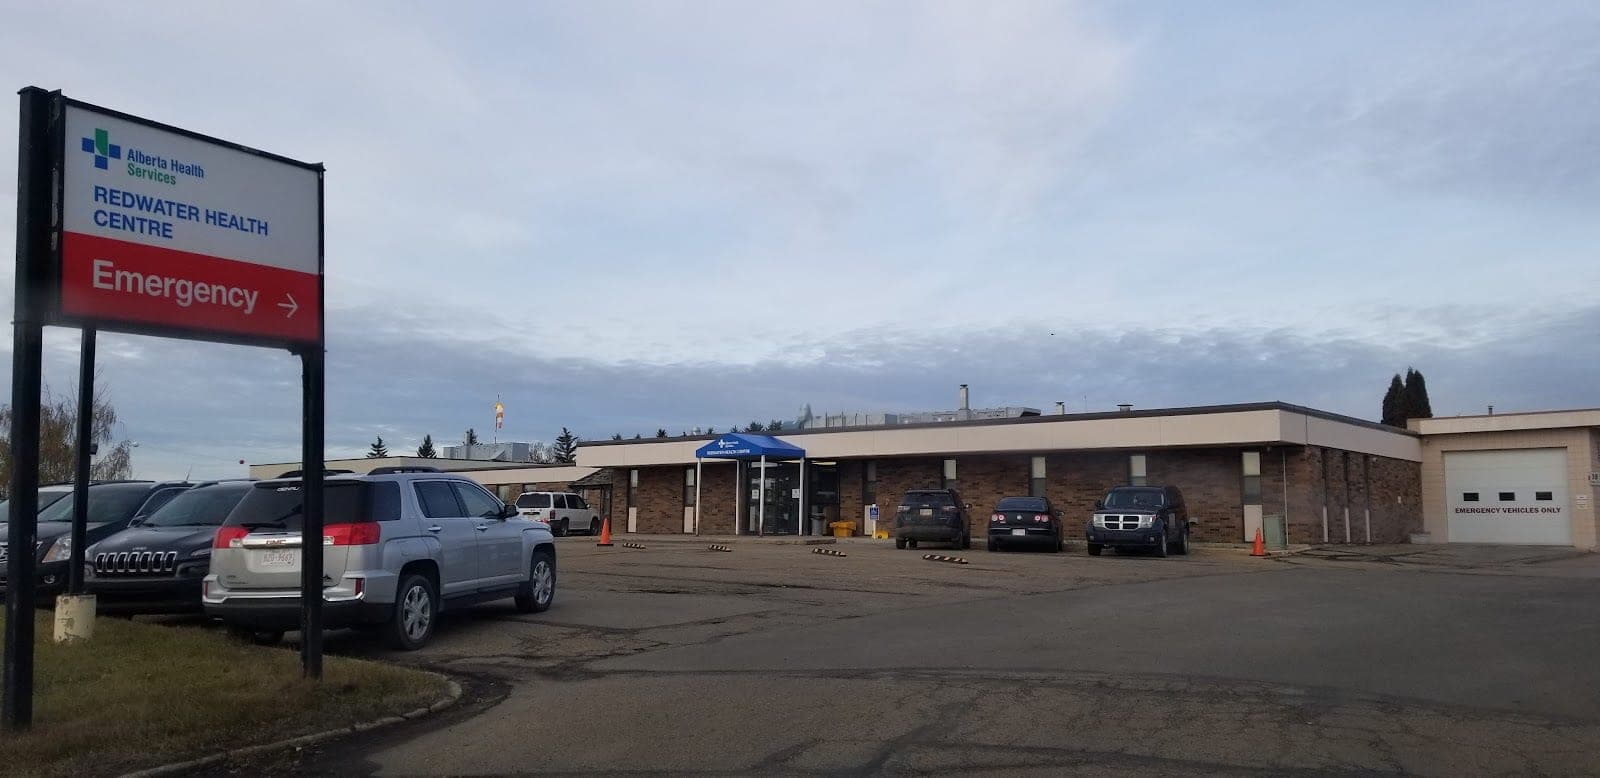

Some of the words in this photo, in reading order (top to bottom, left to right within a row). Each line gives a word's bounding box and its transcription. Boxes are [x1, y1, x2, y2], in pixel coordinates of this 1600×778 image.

[127, 149, 168, 169] Alberta
[171, 159, 205, 179] Health
[127, 163, 177, 186] Services
[93, 209, 174, 239] CENTRE
[94, 185, 200, 222] REDWATER
[205, 210, 269, 237] HEALTH
[92, 258, 259, 315] Emergency
